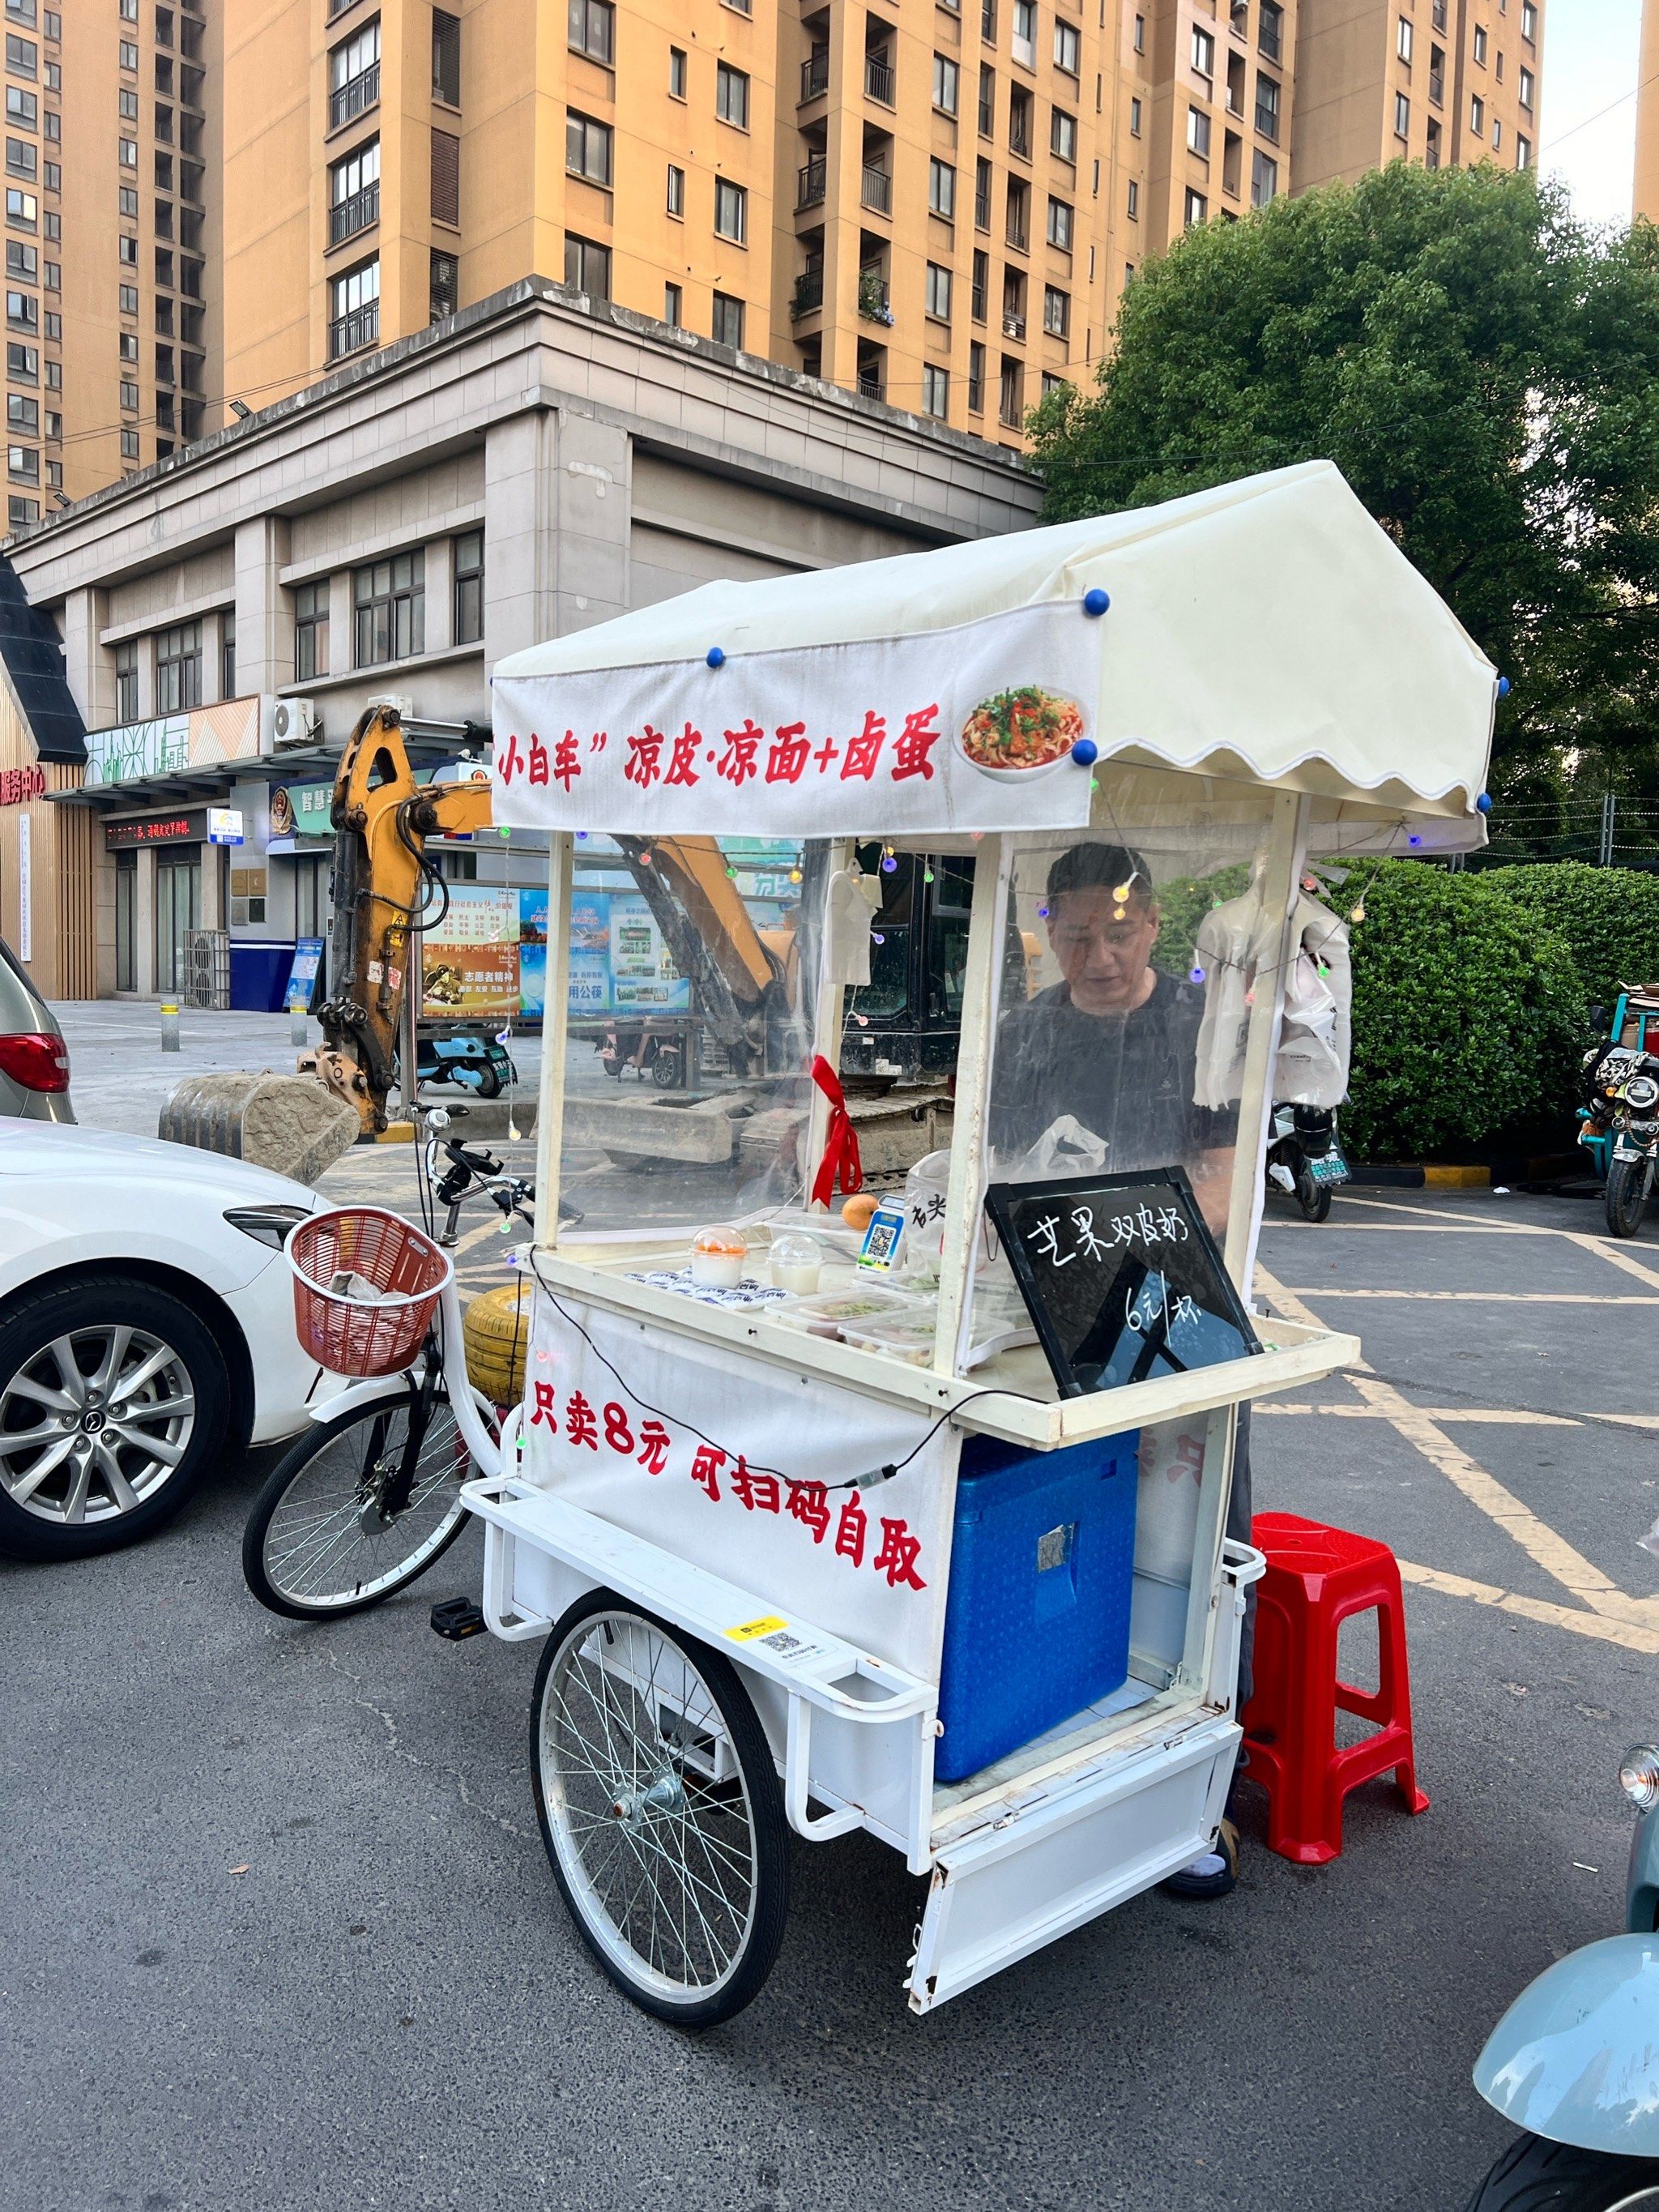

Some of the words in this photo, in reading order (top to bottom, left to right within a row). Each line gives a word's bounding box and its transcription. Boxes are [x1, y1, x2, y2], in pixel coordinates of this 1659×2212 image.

[493, 729, 607, 793] 小白车”
[531, 1381, 671, 1475] 只卖8元
[690, 1445, 928, 1591] 可扫码自取
